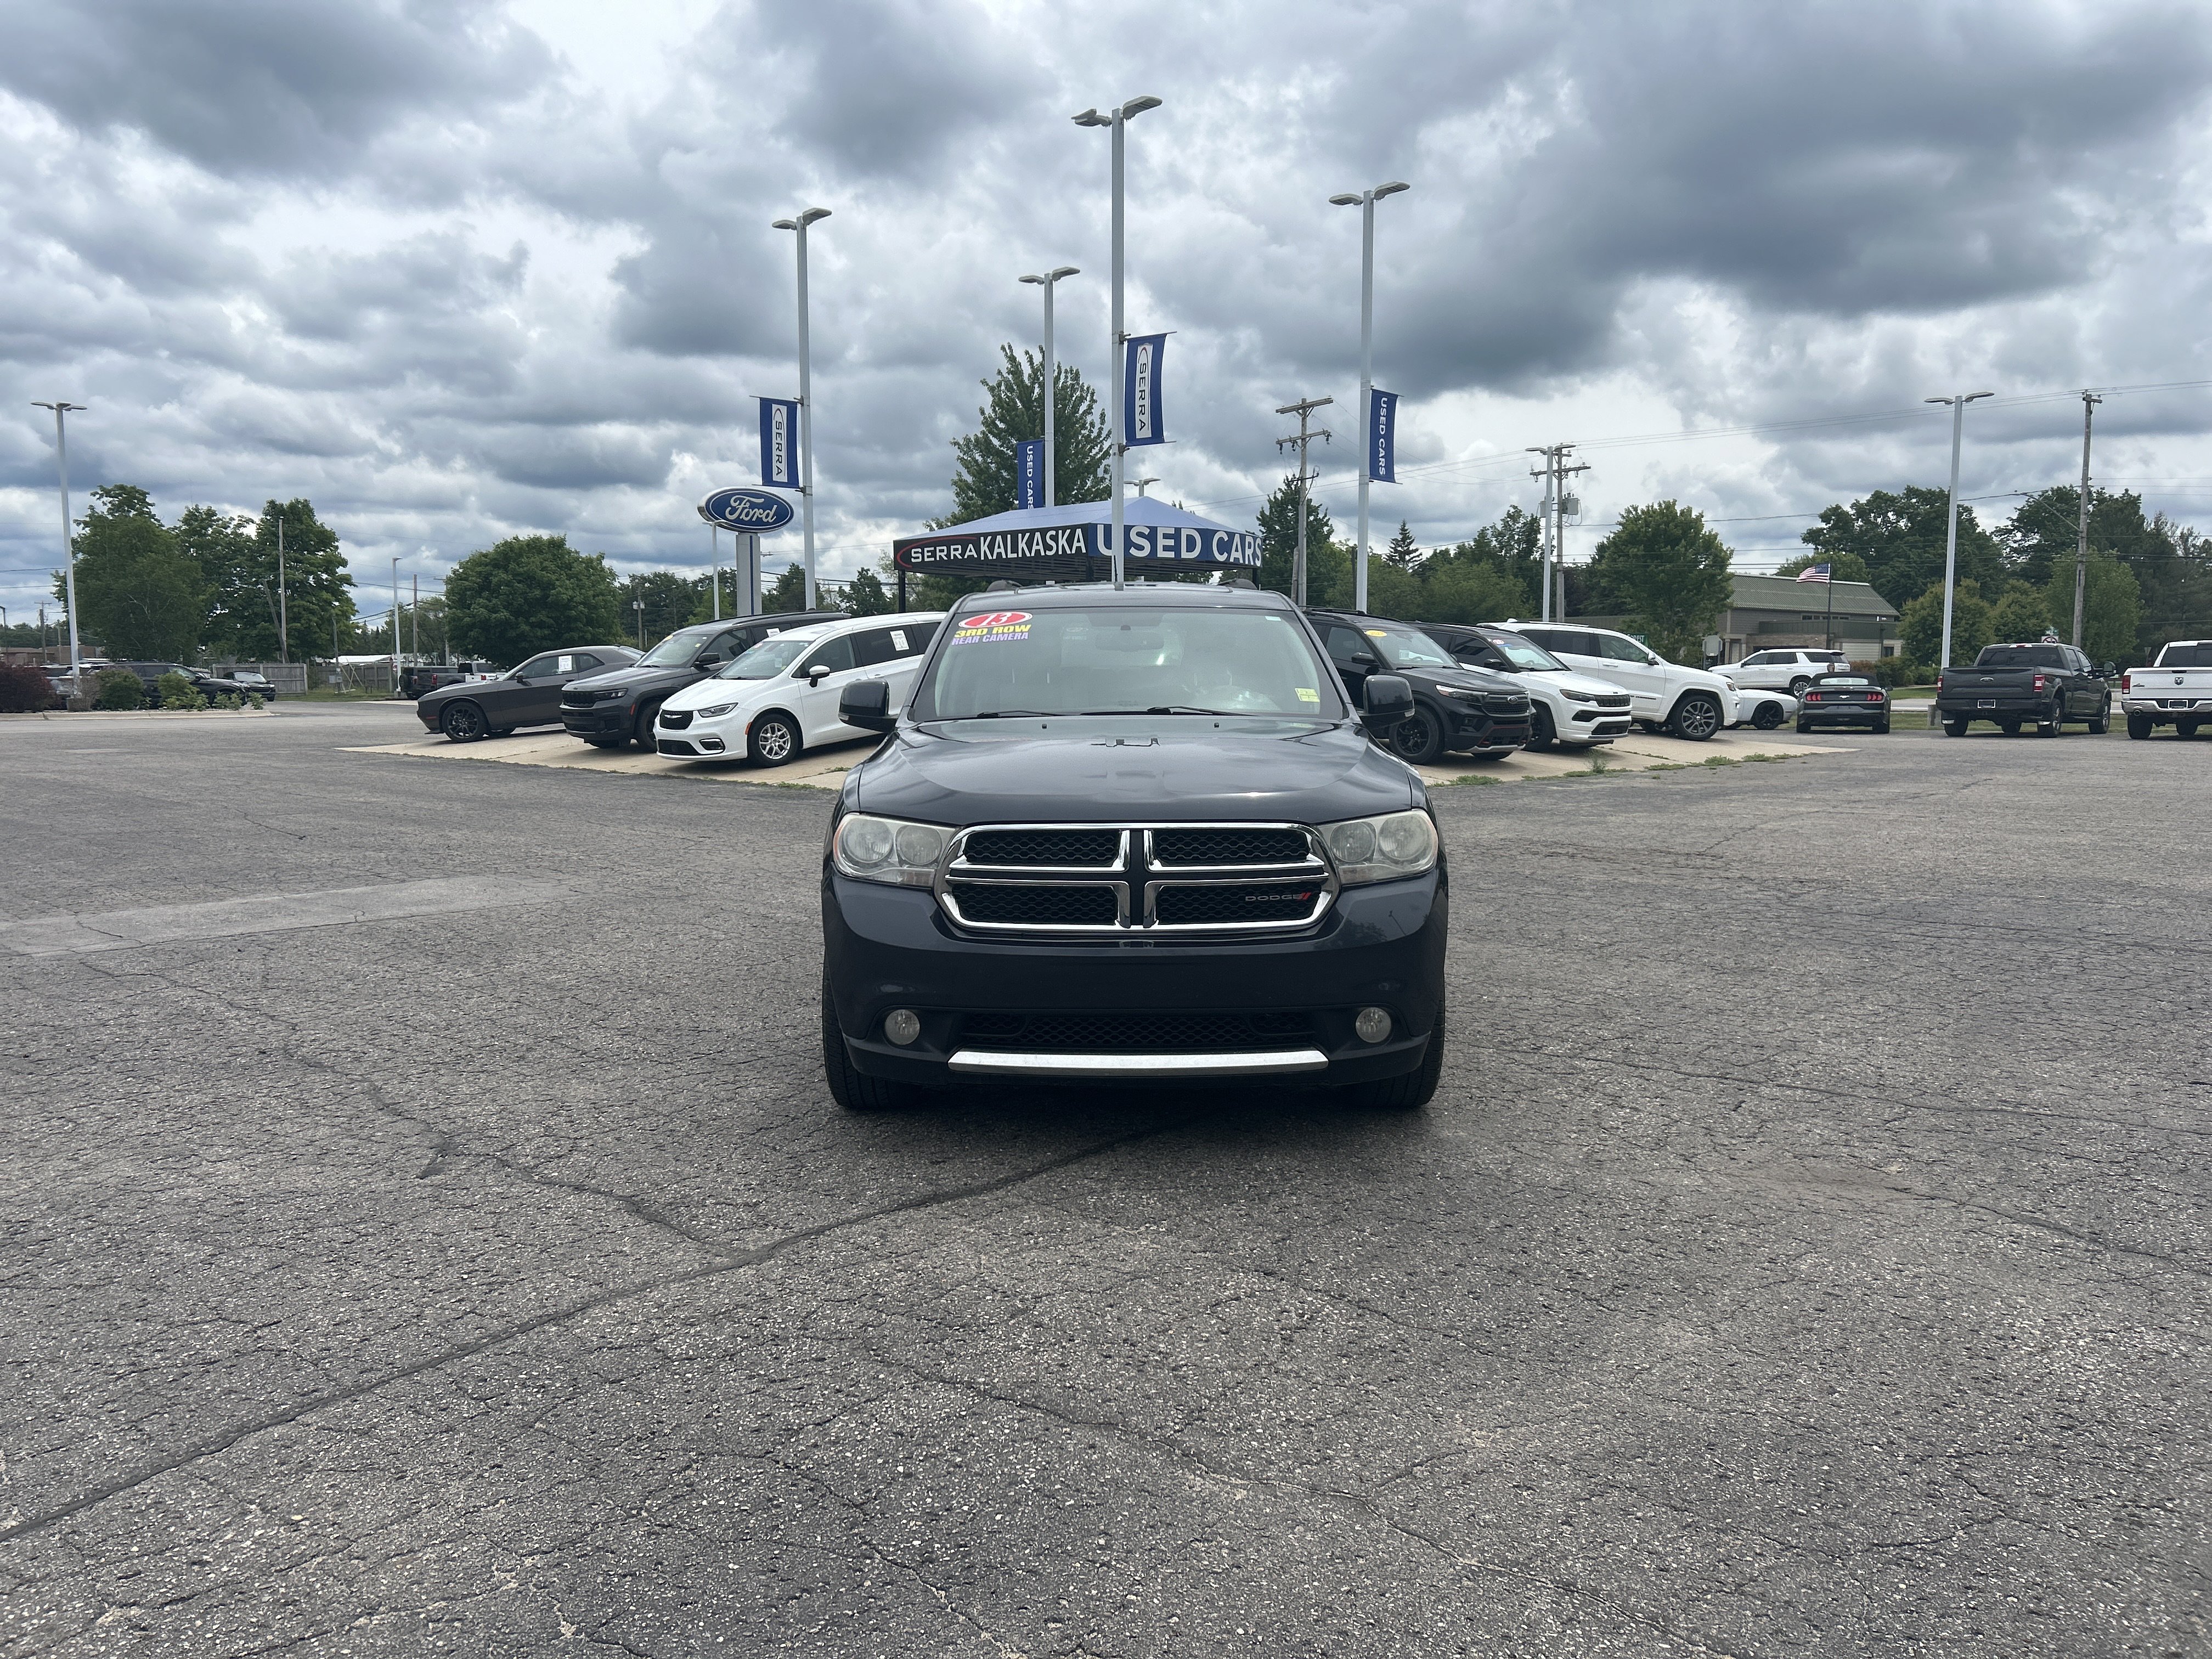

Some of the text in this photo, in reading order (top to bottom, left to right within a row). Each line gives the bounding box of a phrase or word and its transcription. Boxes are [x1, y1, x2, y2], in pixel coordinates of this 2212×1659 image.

[1138, 363, 1147, 432] SERRA
[1379, 397, 1388, 435] USED
[725, 495, 777, 522] Ford
[911, 528, 1086, 562] SERRA KALKASKA
[1097, 524, 1261, 567] USED CARS
[954, 624, 1031, 637] 3RD ROW
[977, 612, 1012, 627] 13
[951, 632, 1029, 646] REAR CAMERA
